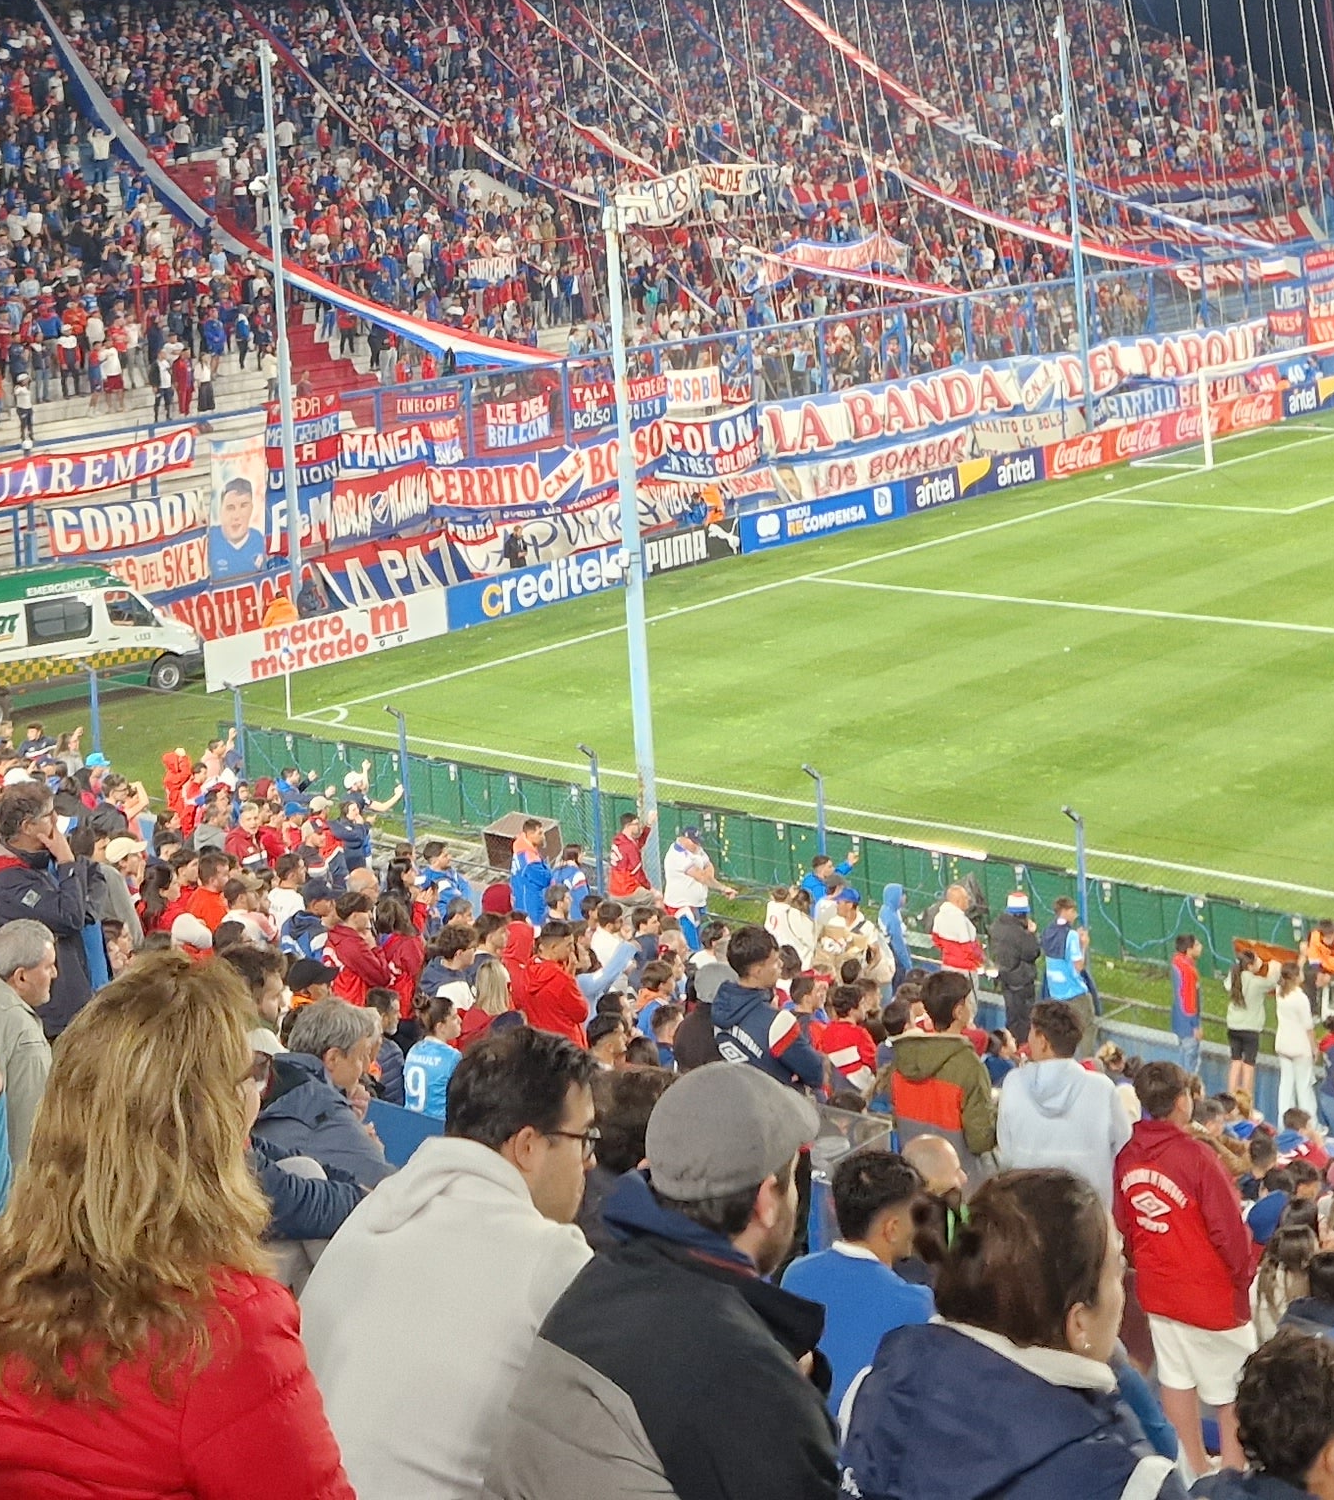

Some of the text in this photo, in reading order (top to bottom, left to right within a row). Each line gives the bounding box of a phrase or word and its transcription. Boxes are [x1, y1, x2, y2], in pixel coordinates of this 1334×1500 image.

[396, 395, 455, 415] CANELONES
[485, 396, 549, 425] LOS DEL
[572, 384, 610, 403] TALA
[765, 403, 834, 453] LA
[843, 369, 1012, 441] BANDA
[1056, 340, 1126, 399] DEL
[1288, 387, 1317, 414] antel
[487, 414, 551, 449] BALCON
[573, 407, 611, 430] BOLSO
[666, 413, 755, 457] COLON
[341, 425, 429, 467] MANGA
[429, 461, 541, 504] CERRITO
[587, 419, 664, 487] BOSO
[868, 431, 968, 480] BOMBOS
[916, 453, 1036, 510] antel antel
[51, 491, 207, 554] CORDON
[787, 504, 867, 537] RECOMPENSA
[142, 561, 162, 586] DEL
[163, 536, 209, 591] SKEY
[645, 529, 708, 574] PUMA
[26, 577, 91, 598] EMERGENCIA
[264, 614, 344, 651] macro
[250, 631, 369, 680] mercado
[406, 1065, 426, 1113] 9
